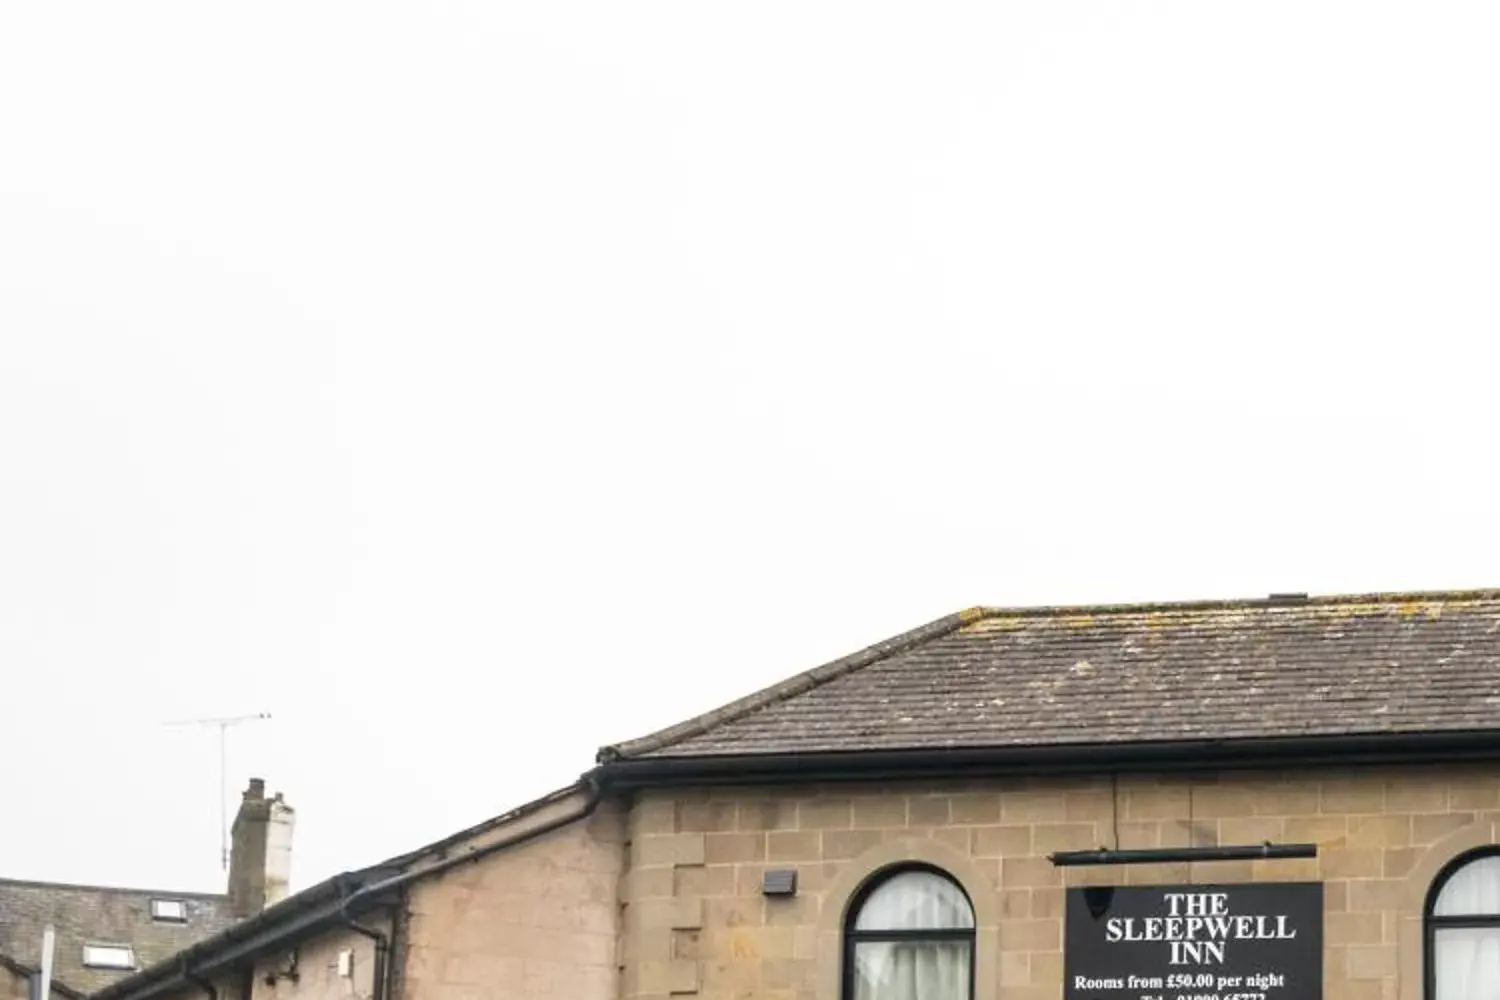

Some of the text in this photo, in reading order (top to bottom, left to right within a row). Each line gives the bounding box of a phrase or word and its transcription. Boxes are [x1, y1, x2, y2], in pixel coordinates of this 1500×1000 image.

[1164, 893, 1229, 917] THE
[1105, 915, 1297, 942] SLEEPWELL
[1168, 941, 1226, 965] INN
[1074, 972, 1285, 991] Rooms from £50.00 per night
